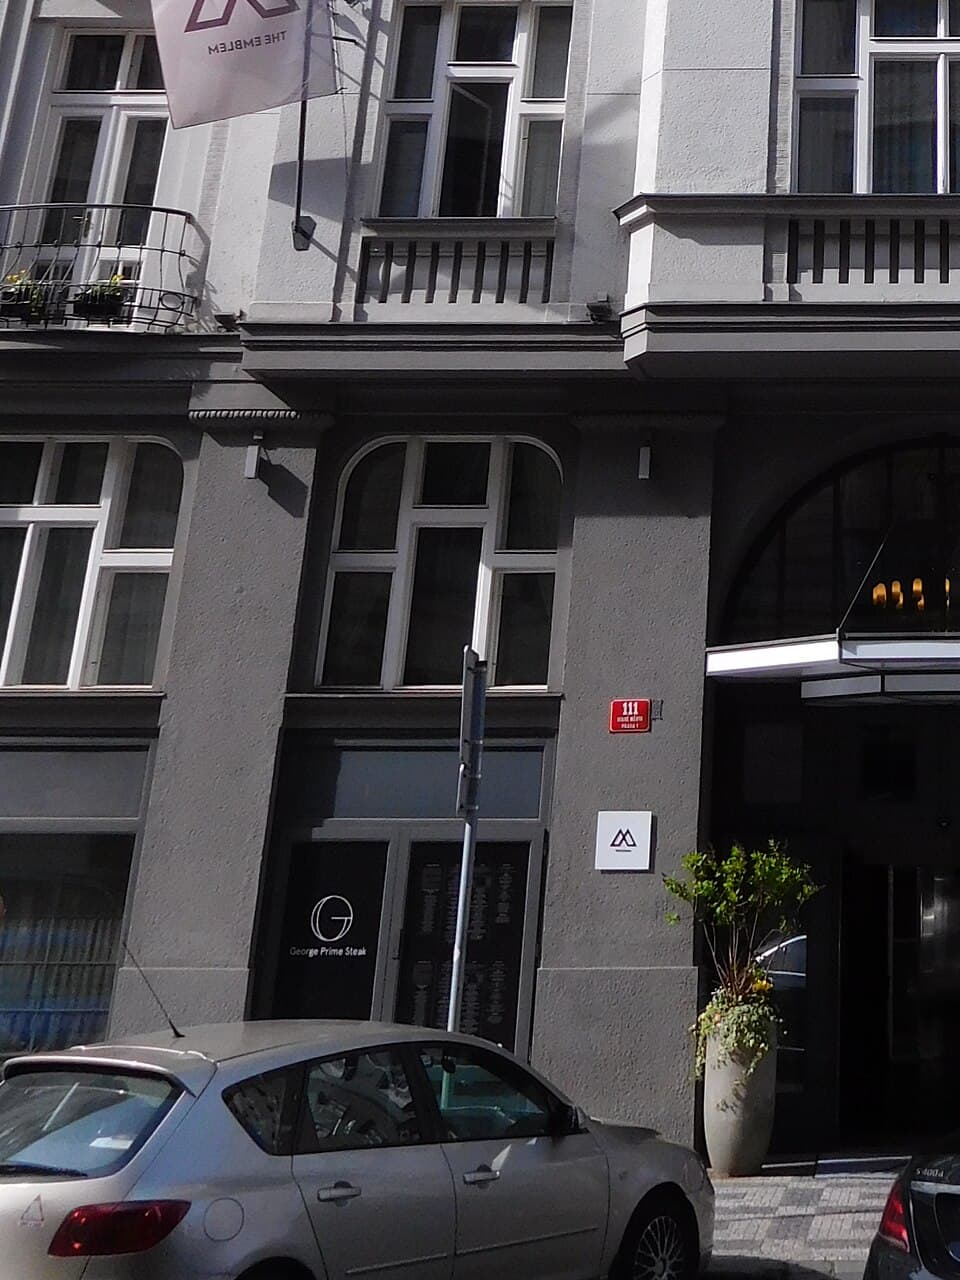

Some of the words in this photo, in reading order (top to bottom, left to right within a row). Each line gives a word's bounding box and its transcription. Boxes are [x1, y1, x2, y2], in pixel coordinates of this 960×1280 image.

[622, 701, 639, 716] 111
[289, 947, 319, 958] George
[320, 946, 344, 956] Prime
[345, 946, 367, 956] Steak
